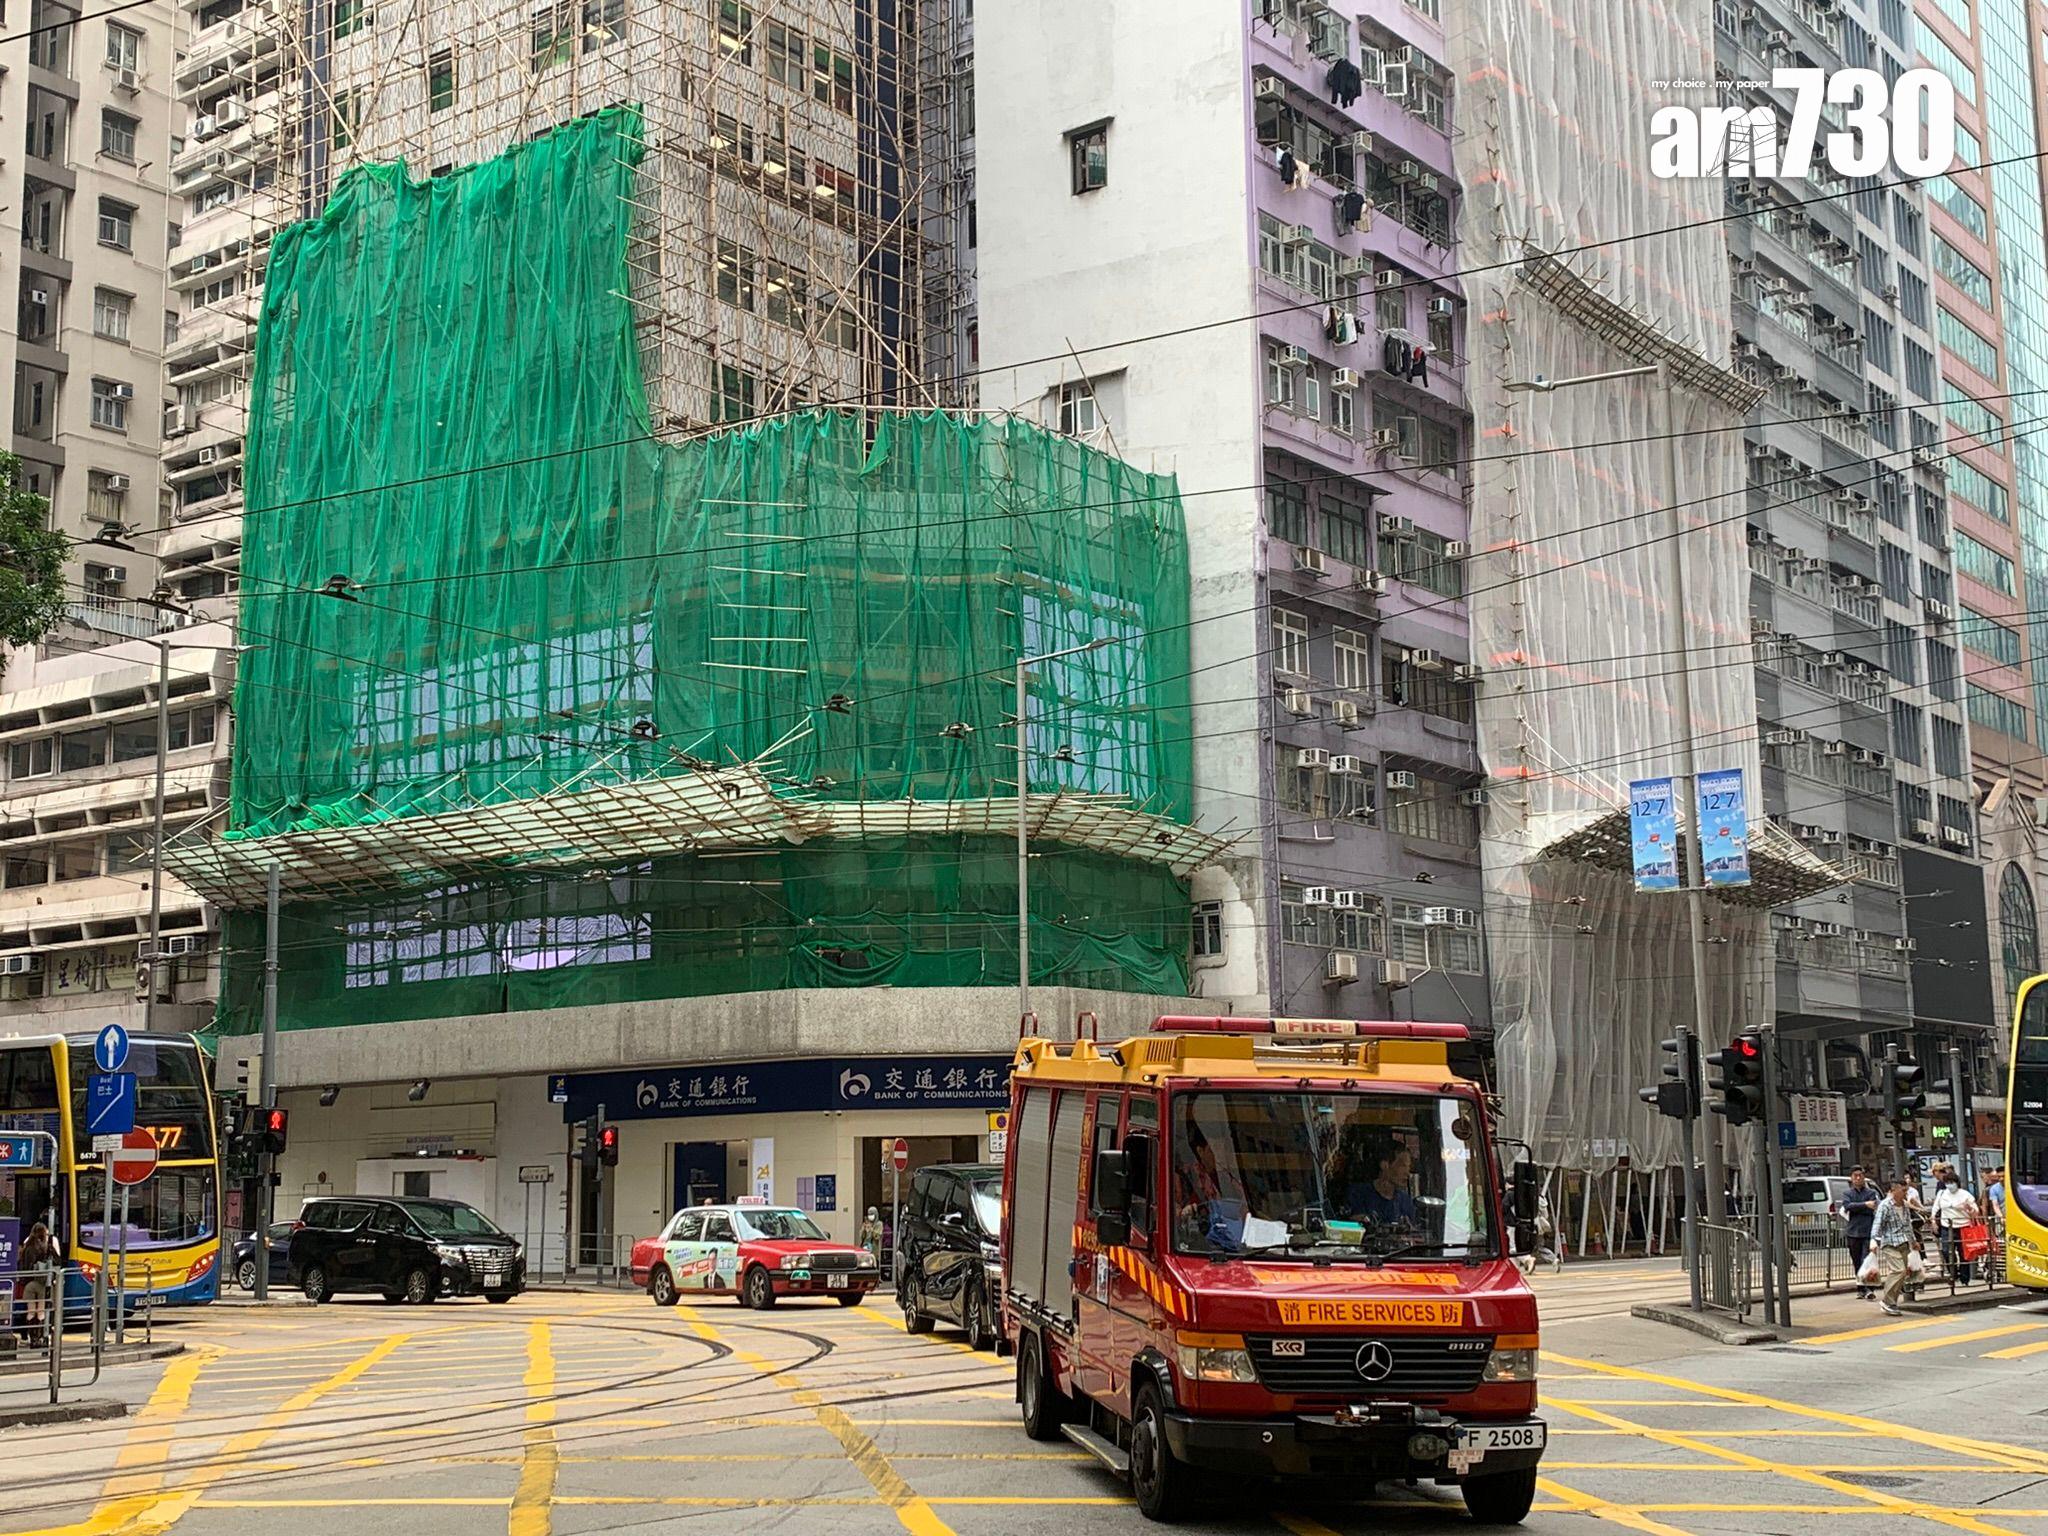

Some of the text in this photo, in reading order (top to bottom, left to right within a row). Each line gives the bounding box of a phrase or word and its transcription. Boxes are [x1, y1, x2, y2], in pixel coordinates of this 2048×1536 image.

[1287, 1022, 1343, 1033] FIRE
[667, 1074, 750, 1099] 交通銀行
[885, 1068, 998, 1091] 交通銀行
[660, 1096, 757, 1109] BANK OF COMMUNICATIONS
[874, 1089, 1008, 1100] BANK OF COMMUNICATIONS
[1302, 1273, 1414, 1283] RESCUE
[1284, 1302, 1459, 1323] 消 FIRE SERVICES 防
[1468, 1428, 1534, 1447] F 2508
